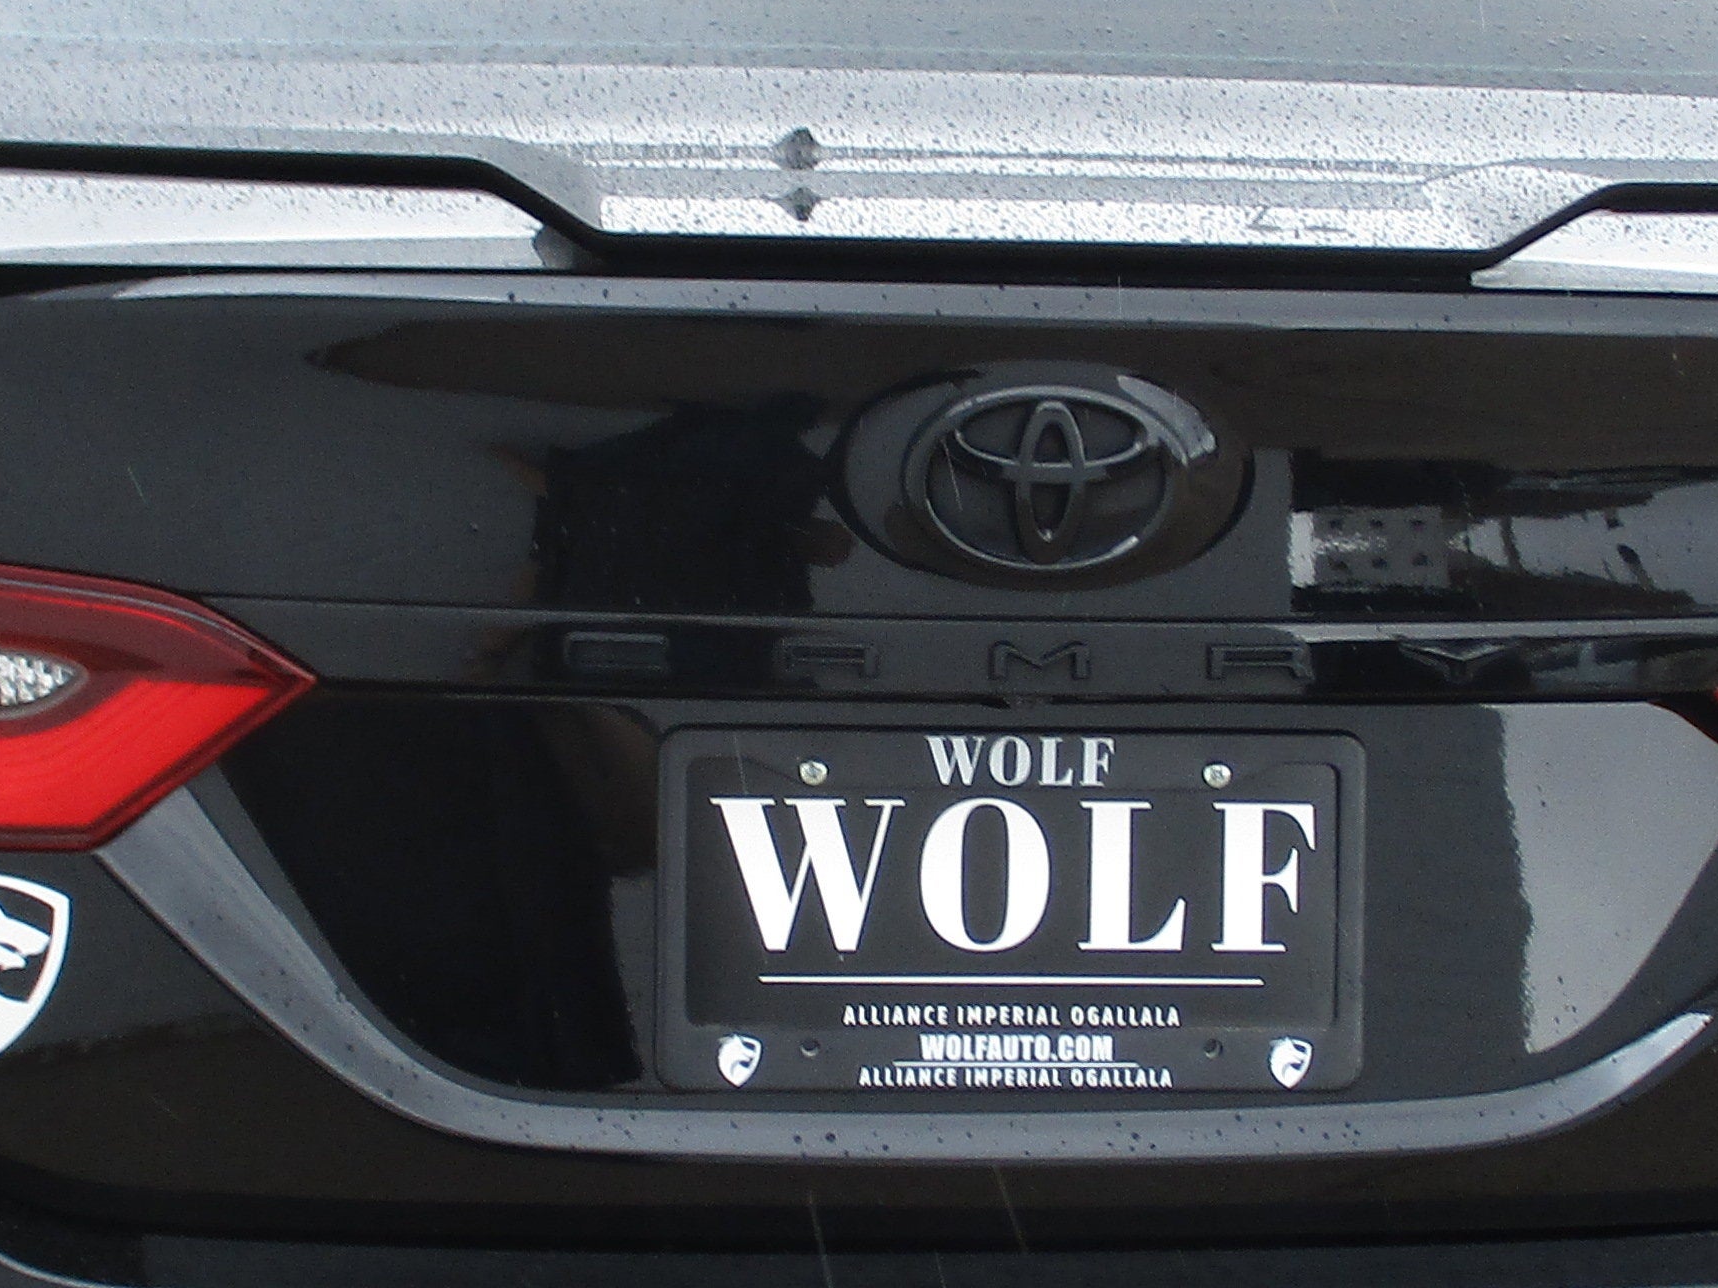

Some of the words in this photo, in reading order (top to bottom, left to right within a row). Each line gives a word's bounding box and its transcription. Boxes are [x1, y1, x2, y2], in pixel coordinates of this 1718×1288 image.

[563, 629, 1509, 686] CAMRY
[925, 735, 1115, 787] WOLF
[709, 797, 1317, 952] WOLF
[843, 1004, 949, 1027] ALLIANCE
[957, 1004, 1061, 1027] IMPERIAL
[1070, 1005, 1180, 1028] OGALLALA
[919, 1034, 1113, 1062] WOLFAUTO.COM
[859, 1066, 960, 1088] ALLIANCE
[963, 1066, 1064, 1088] IMPERIAL
[1069, 1066, 1173, 1088] OGALLALA
